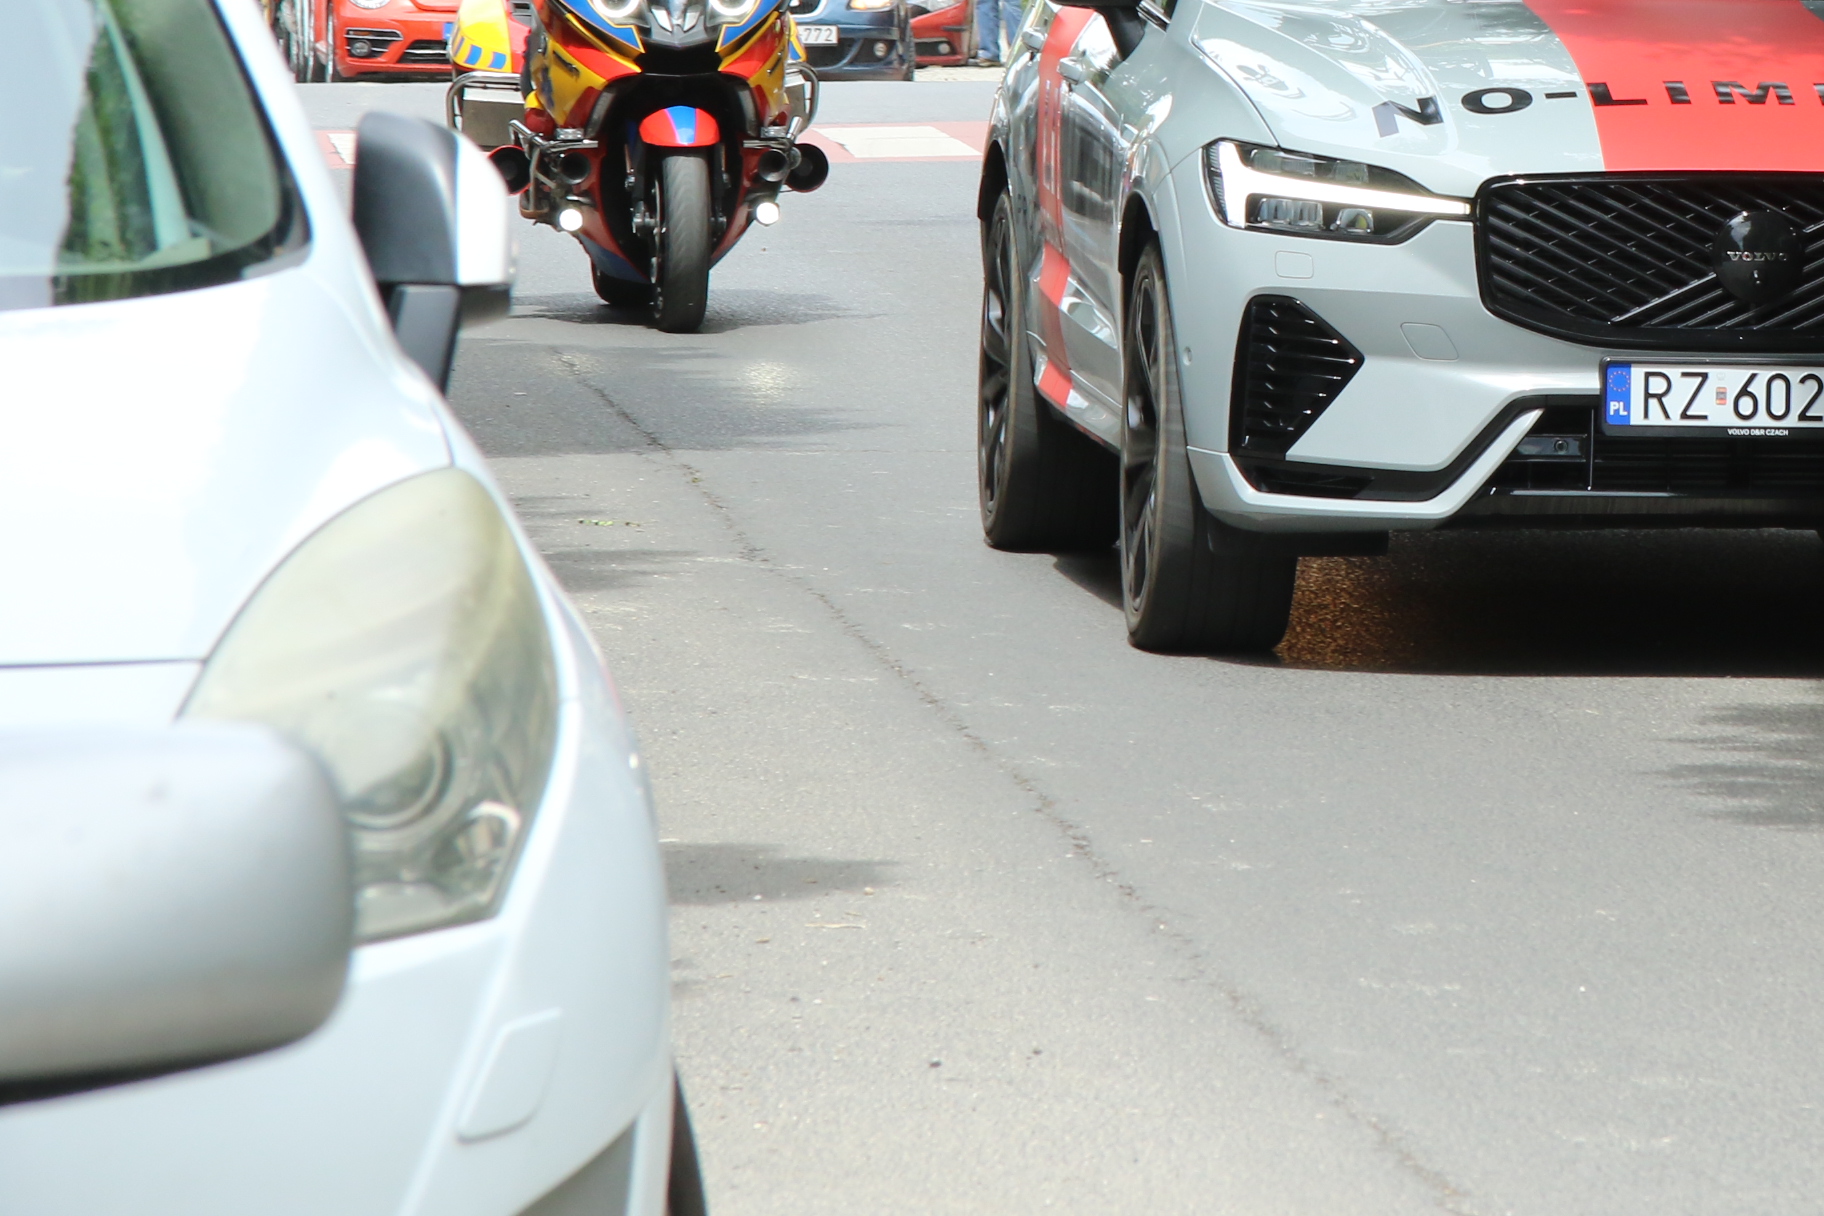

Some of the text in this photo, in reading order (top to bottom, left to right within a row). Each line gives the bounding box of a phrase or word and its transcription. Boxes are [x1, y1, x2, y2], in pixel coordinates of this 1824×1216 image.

[1726, 251, 1788, 262] VOLVO
[1609, 401, 1628, 416] PL
[1642, 371, 1710, 421] RZ
[1727, 428, 1750, 436] VOLVO
[1765, 428, 1789, 437] CZACH
